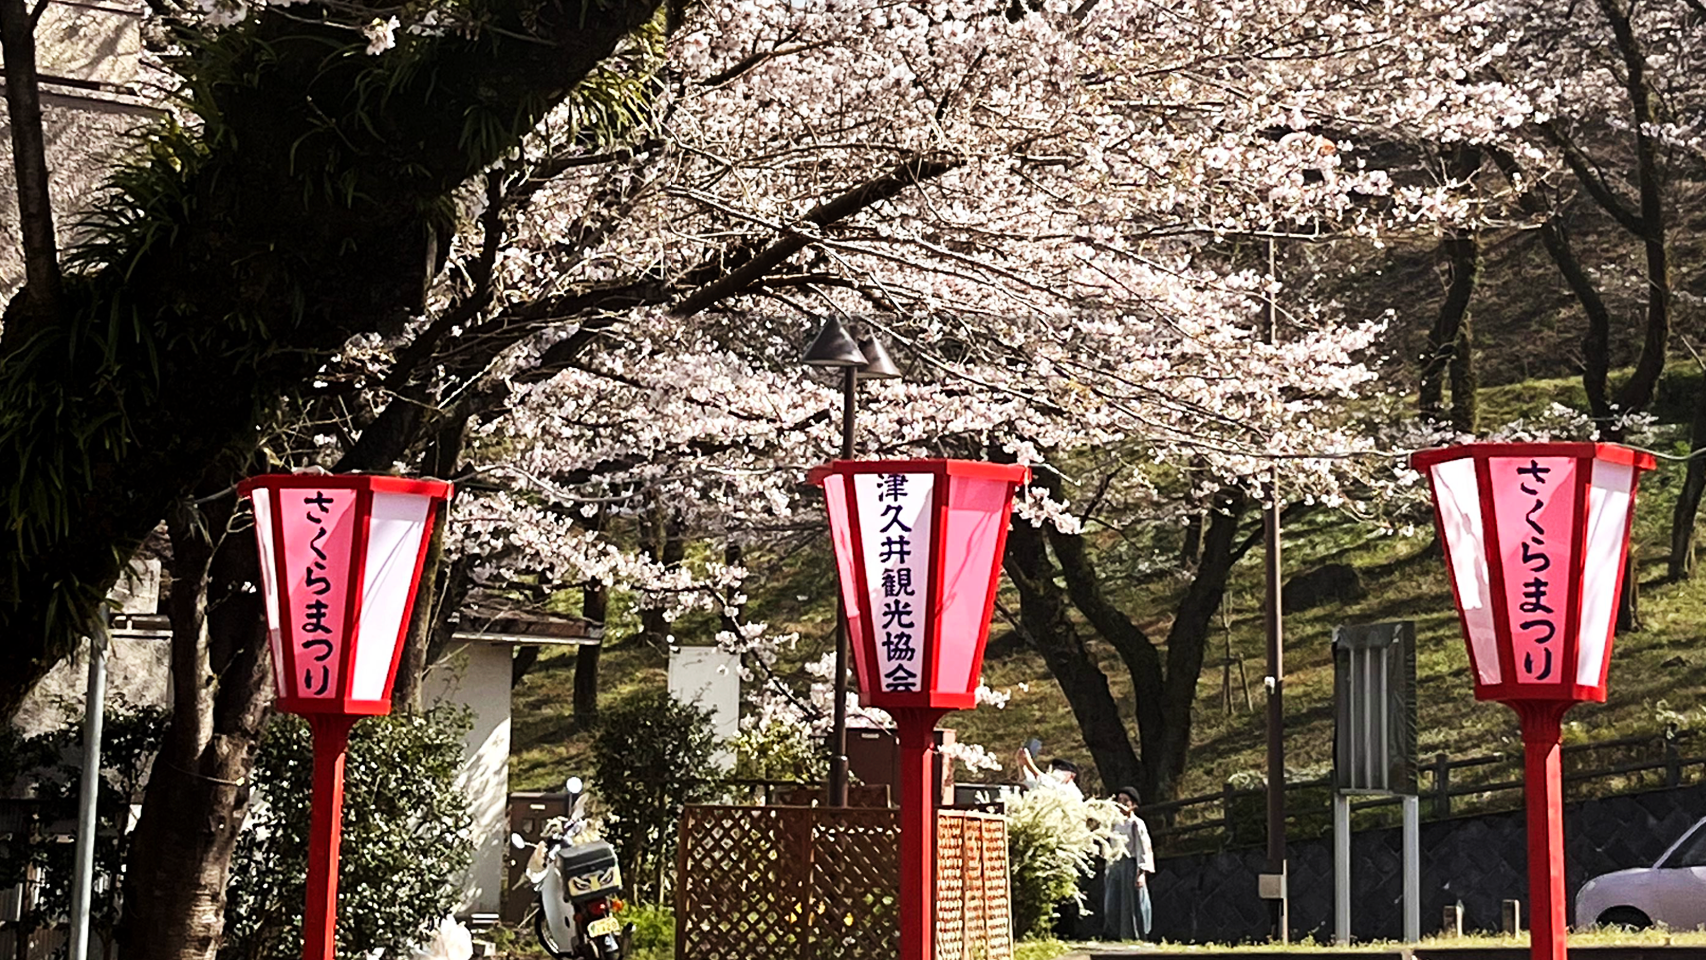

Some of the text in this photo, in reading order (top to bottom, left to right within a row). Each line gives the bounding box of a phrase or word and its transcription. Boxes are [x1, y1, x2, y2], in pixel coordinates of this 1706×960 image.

[302, 491, 334, 695] さくらまつり
[876, 473, 917, 692] 津久井観光協会
[1517, 459, 1556, 680] さくらまつり
